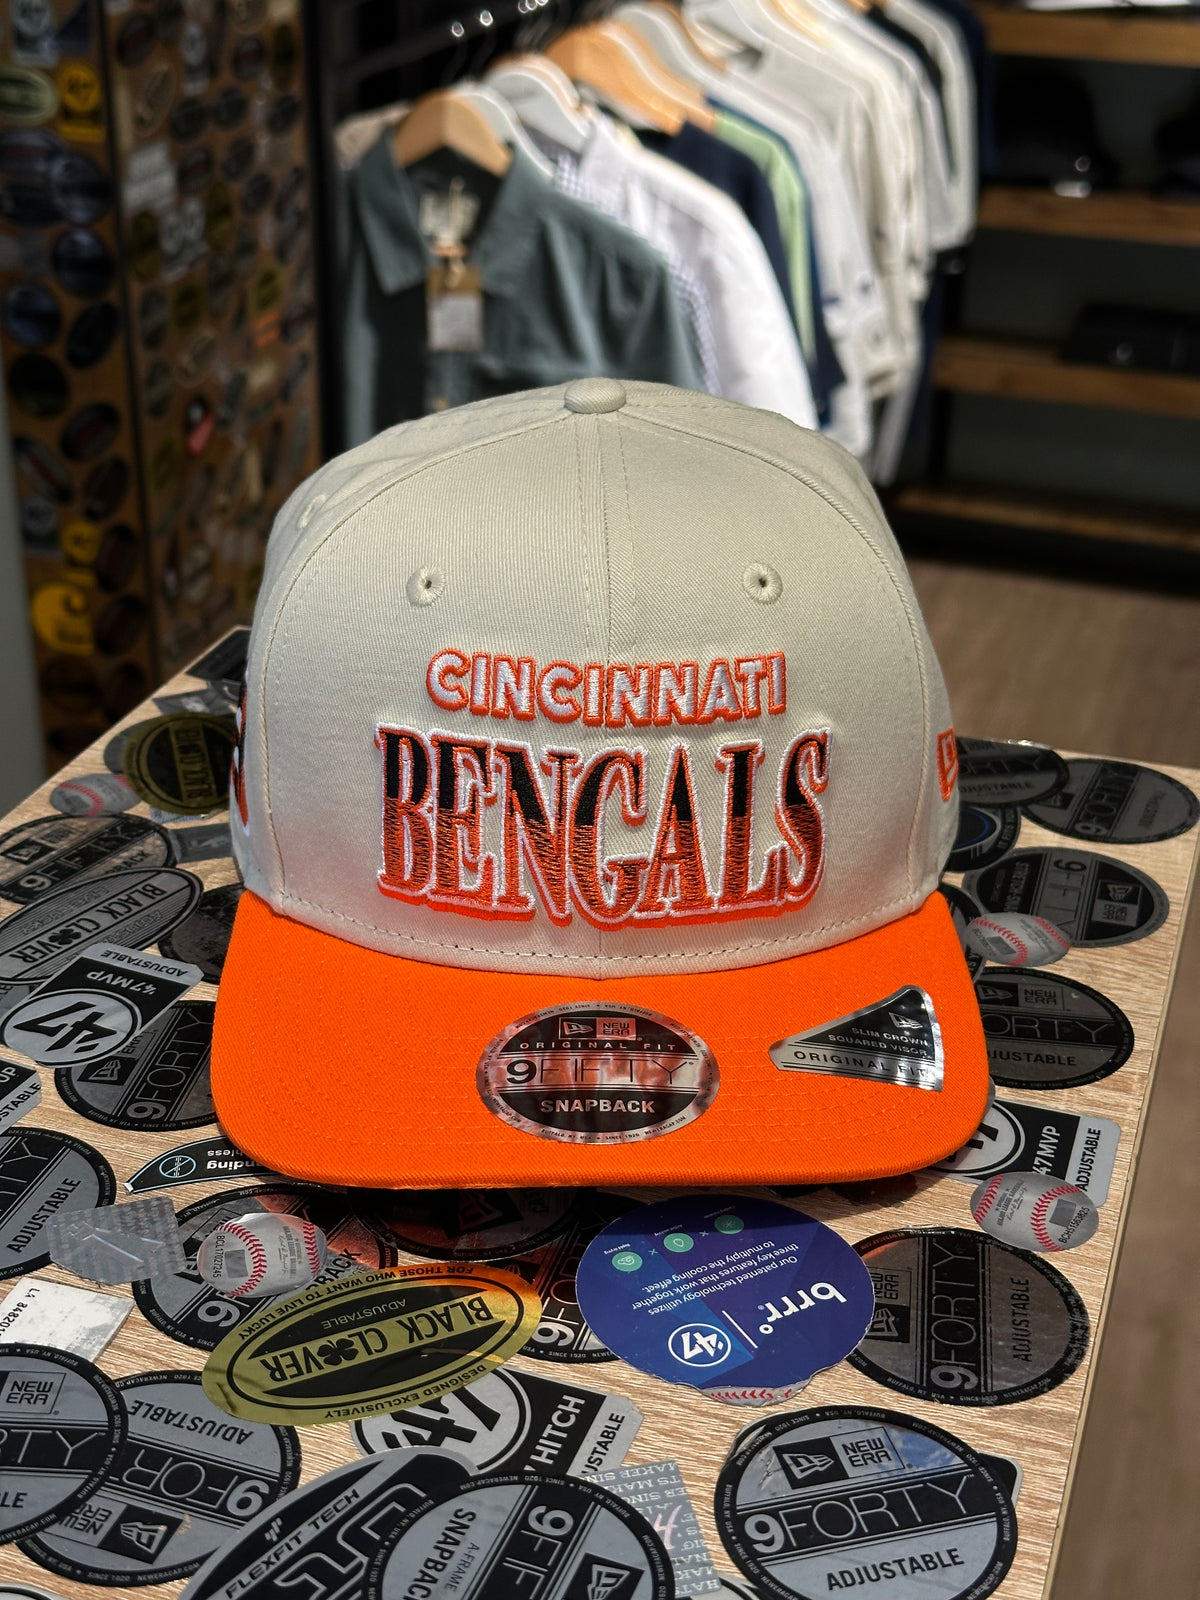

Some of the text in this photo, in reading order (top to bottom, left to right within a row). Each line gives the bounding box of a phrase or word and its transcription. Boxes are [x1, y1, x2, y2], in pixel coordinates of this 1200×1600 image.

[426, 648, 786, 728] CINCINNATI
[373, 722, 833, 931] BENGALS
[96, 883, 167, 920] BLACK
[101, 950, 189, 978] ADJUSTABLE
[1024, 989, 1057, 998] NEW
[603, 1028, 630, 1036] ERA
[852, 1027, 928, 1047] SLIM CROWN
[981, 1014, 1108, 1044] ORTY
[520, 1041, 676, 1051] ORIGINAL FIT
[828, 1034, 927, 1056] SQUARED VISOR
[988, 1051, 1078, 1067] JUSTABLE
[126, 1006, 213, 1121] 9FORTY
[506, 1058, 689, 1085] 9FIFTY
[794, 1051, 929, 1077] ORIGINAL FIT
[0, 1081, 41, 1122] STABLE
[540, 1099, 655, 1114] SNAPBACK
[206, 1160, 262, 1171] nding
[1075, 1127, 1101, 1192] ADJUSTABLE
[7, 1177, 82, 1254] ADJUSTABLE
[366, 1271, 396, 1284] WHO
[400, 1266, 444, 1277] THOSE
[446, 1265, 474, 1274] FOR
[632, 1243, 799, 1311] three key features that work together
[642, 1240, 775, 1293] to multiply the cooling effect.
[305, 1289, 327, 1303] TO
[327, 1278, 364, 1295] WANT
[648, 1256, 798, 1316] Our patented technology utilizes
[884, 1273, 900, 1300] ERA
[275, 1298, 305, 1317] LIVE
[321, 1298, 406, 1330] ADJUSTABLE
[398, 1295, 494, 1343] BLACK
[930, 1243, 978, 1390] 9FORTY
[1010, 1276, 1033, 1363] ADJUSTABLE
[239, 1312, 276, 1340] LUCKY
[6, 1392, 49, 1405] ERA
[10, 1380, 54, 1393] NEW
[324, 1364, 487, 1419] DESIGNED EXCLUSIVELY
[127, 1399, 254, 1446] ADJUSTABLE
[531, 1394, 587, 1465] HITCH
[582, 1412, 625, 1475] USTABLE
[841, 1437, 885, 1457] NEW
[849, 1450, 893, 1468] ERA
[110, 1449, 270, 1517] 9FOR
[658, 1475, 681, 1486] TS
[744, 1475, 968, 1554] 9FORTY
[224, 1531, 304, 1600] FLEXFIT
[307, 1488, 361, 1530] TECH
[401, 1508, 477, 1600] SNAPBAC
[502, 1505, 575, 1600] 9FIF
[443, 1541, 480, 1592] A-FRAME
[826, 1548, 966, 1591] ADJUSTABLE
